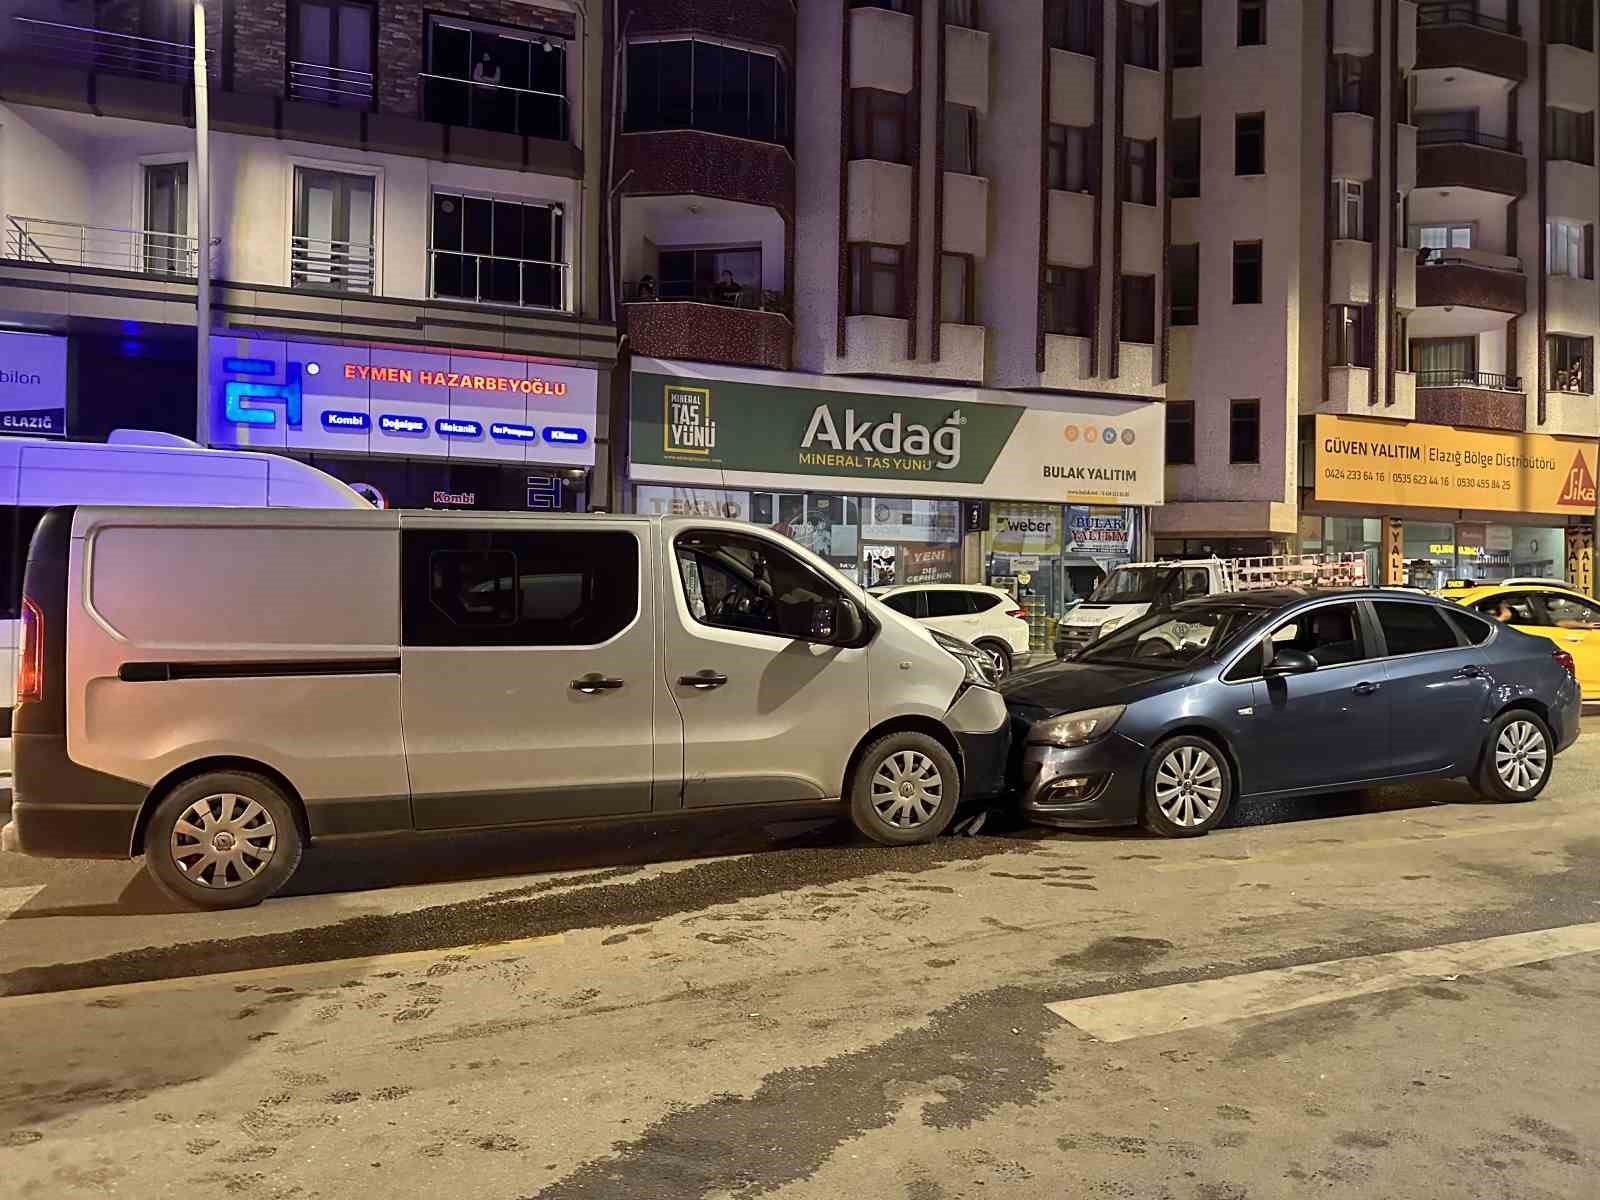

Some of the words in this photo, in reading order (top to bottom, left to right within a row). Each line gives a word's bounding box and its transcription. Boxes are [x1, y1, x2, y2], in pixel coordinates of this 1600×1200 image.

[344, 364, 412, 383] EYMEN
[419, 371, 566, 396] HAZARBEYOĞLU
[3, 415, 53, 429] ELAZIĞ
[328, 414, 363, 425] Kombi
[1325, 437, 1367, 456] GÜVEN
[1371, 443, 1420, 460] YALITIM
[1429, 447, 1461, 467] Elazığ
[1043, 465, 1085, 479] BULAK
[1088, 468, 1137, 481] YALITIM
[1563, 468, 1596, 500] Sika
[433, 491, 474, 504] Kombi
[1008, 519, 1051, 532] weber
[1077, 517, 1122, 529] BULAK
